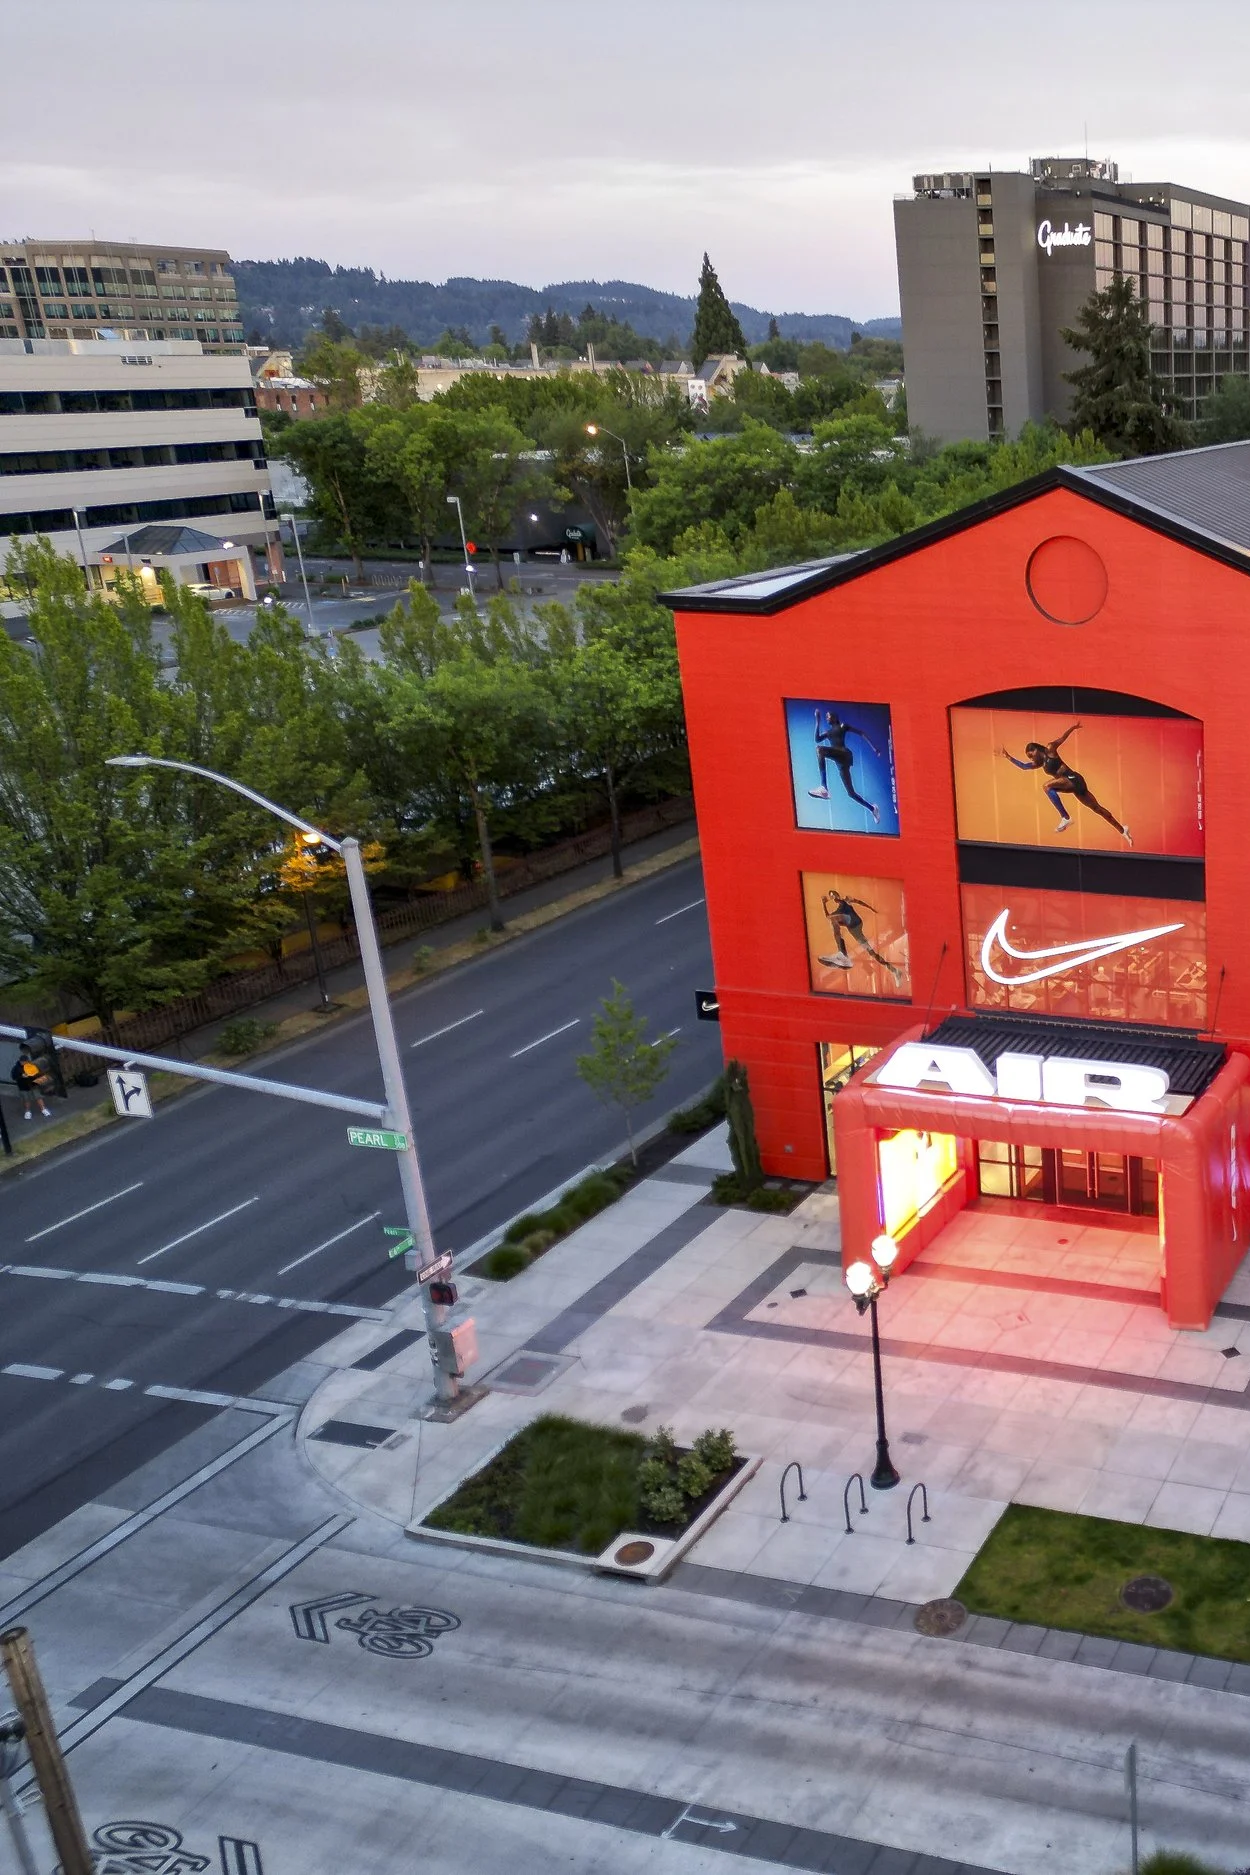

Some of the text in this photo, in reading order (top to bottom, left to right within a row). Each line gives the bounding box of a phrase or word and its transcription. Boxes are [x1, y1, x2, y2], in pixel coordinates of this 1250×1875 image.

[1038, 220, 1091, 256] Graduate
[876, 1042, 1170, 1113] AIR
[350, 1131, 388, 1147] PEARL
